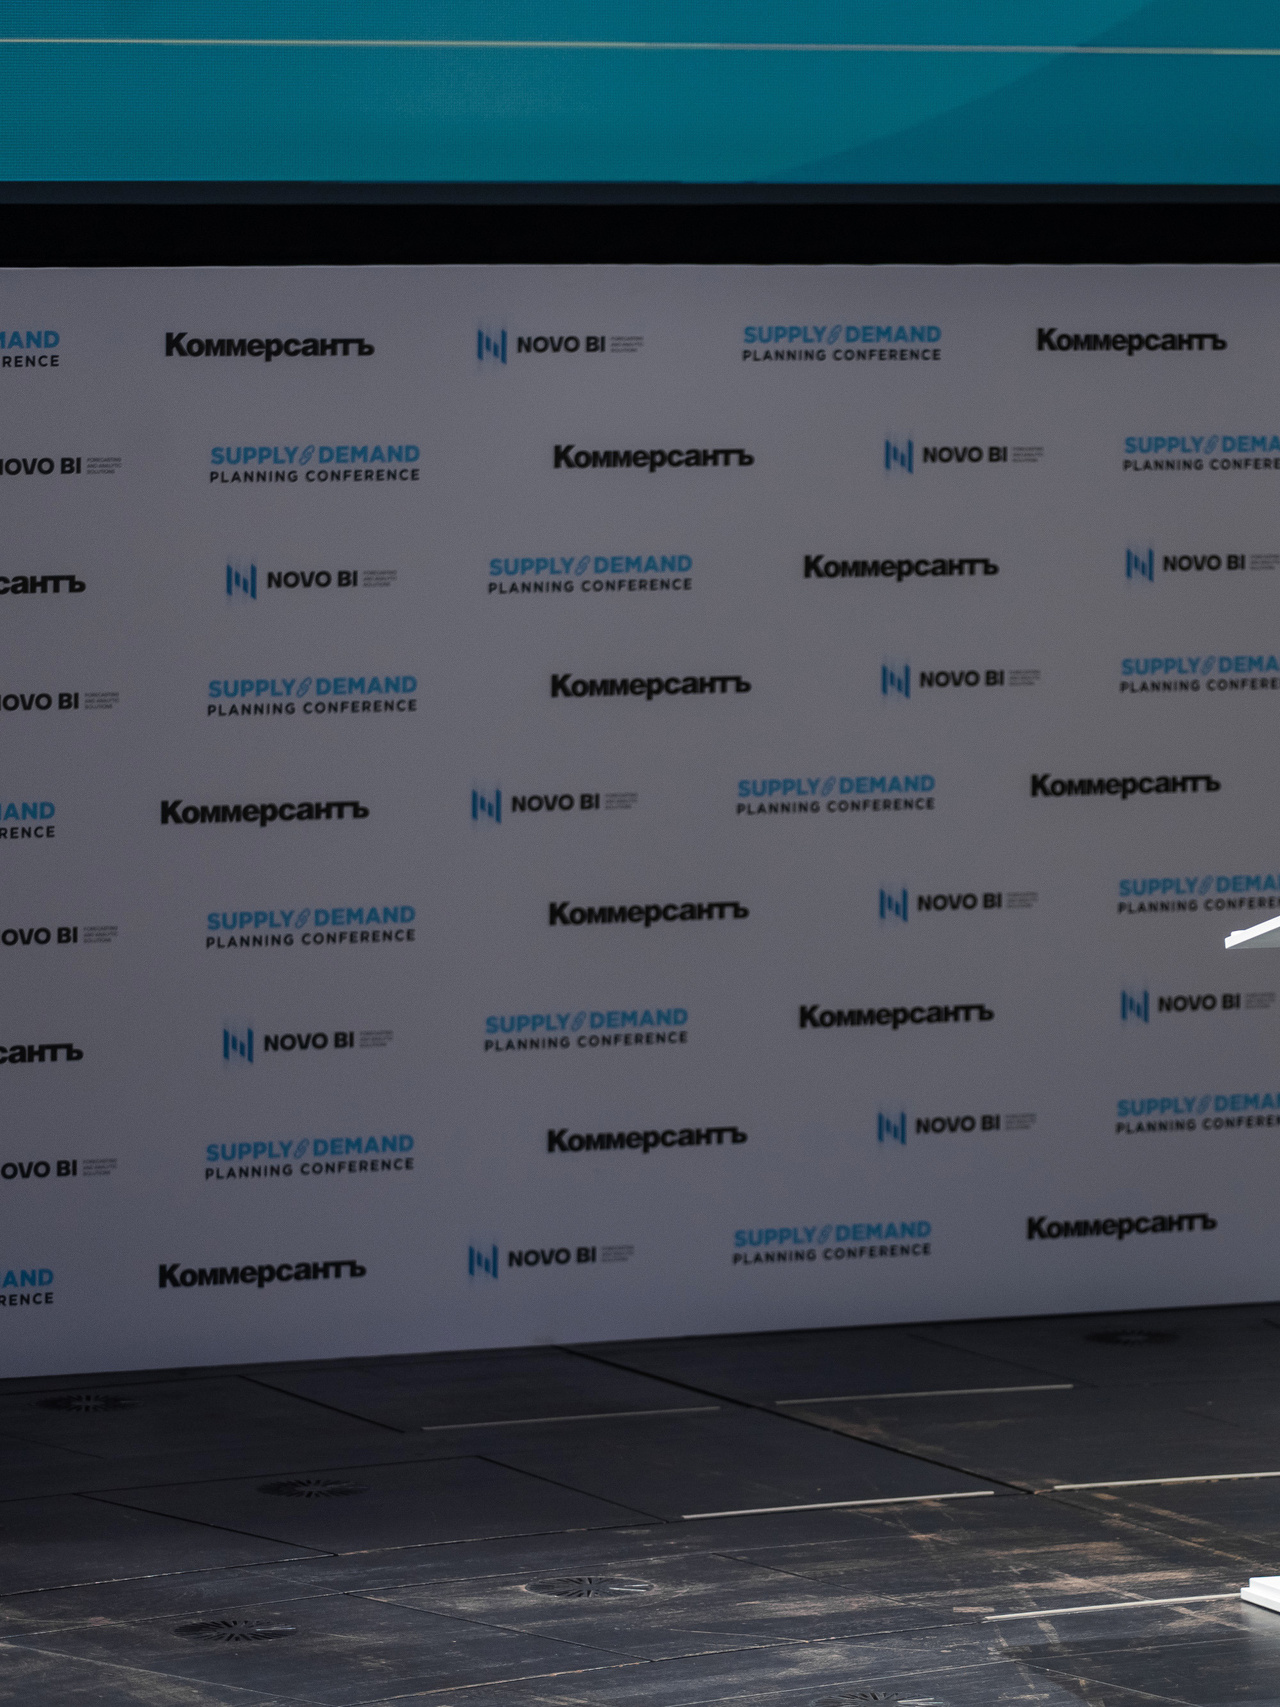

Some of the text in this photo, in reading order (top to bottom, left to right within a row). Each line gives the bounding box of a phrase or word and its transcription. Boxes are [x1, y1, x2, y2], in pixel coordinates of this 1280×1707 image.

[516, 334, 581, 354] NOVO
[584, 334, 607, 354] BI
[743, 324, 943, 345] SUPPLY DEMAND
[1035, 326, 1229, 358] Коммерсантъ
[164, 331, 376, 364] Коммерсантъ
[741, 347, 941, 363] PLANNING CONFERENCE
[210, 444, 421, 466] SUPPLY DEMAND
[921, 445, 985, 464] NOVO
[987, 445, 1009, 464] BI
[1124, 435, 1205, 455] SUPPLY
[0, 456, 83, 477] OVO BI
[552, 443, 756, 474] Коммерсантъ
[1122, 457, 1204, 472] PLANNING
[208, 467, 420, 484] PLANNING CONFERENCE
[488, 553, 694, 577] SUPPLY DEMAND
[802, 553, 1001, 584] Коммерсантъ
[1161, 553, 1223, 573] NOVO
[1225, 553, 1247, 572] BI
[266, 569, 333, 590] NOVO
[336, 569, 359, 589] BI
[487, 577, 692, 595] PLANNING CONFERENCE
[1120, 656, 1202, 677] SUPPLY
[207, 674, 418, 699] SUPPLY DEMAND
[549, 672, 753, 702] Коммерсантъ
[918, 669, 982, 689] NOVO
[983, 668, 1006, 688] BI
[0, 692, 54, 713] OVO
[57, 691, 80, 711] BI
[206, 698, 417, 718] PLANNING CONFERENCE
[737, 773, 936, 799] SUPPLY DEMAND
[1029, 772, 1223, 802] Коммерсантъ
[159, 798, 371, 829] Коммерсантъ
[510, 792, 576, 814] NOVO
[578, 792, 601, 812] BI
[735, 796, 935, 816] PLANNING CONFERENCE
[1118, 876, 1199, 898] SUPPLY
[916, 892, 979, 913] NOVO
[981, 891, 1003, 911] BI
[206, 904, 417, 932] SUPPLY DEMAND
[547, 900, 751, 930] Коммерсантъ
[205, 926, 416, 950] PLANNING CONFERENCE
[1156, 993, 1218, 1014] NOVO
[1220, 992, 1242, 1011] BI
[484, 1007, 689, 1035] SUPPLY DEMAND
[797, 1002, 996, 1032] Коммерсантъ
[262, 1031, 330, 1053] NOVO
[332, 1030, 356, 1050] BI
[483, 1029, 688, 1053] PLANNING CONFERENCE
[914, 1114, 977, 1135] NOVO
[979, 1113, 1002, 1133] BI
[205, 1133, 415, 1163] SUPPLY DEMAND
[545, 1125, 749, 1155] Коммерсантъ
[204, 1156, 414, 1181] PLANNING CONFERENCE
[733, 1219, 933, 1249] SUPPLY DEMAND
[1025, 1212, 1219, 1242] Коммерсантъ
[507, 1246, 572, 1269] NOVO
[574, 1245, 598, 1265] BI
[157, 1258, 368, 1290] Коммерсантъ
